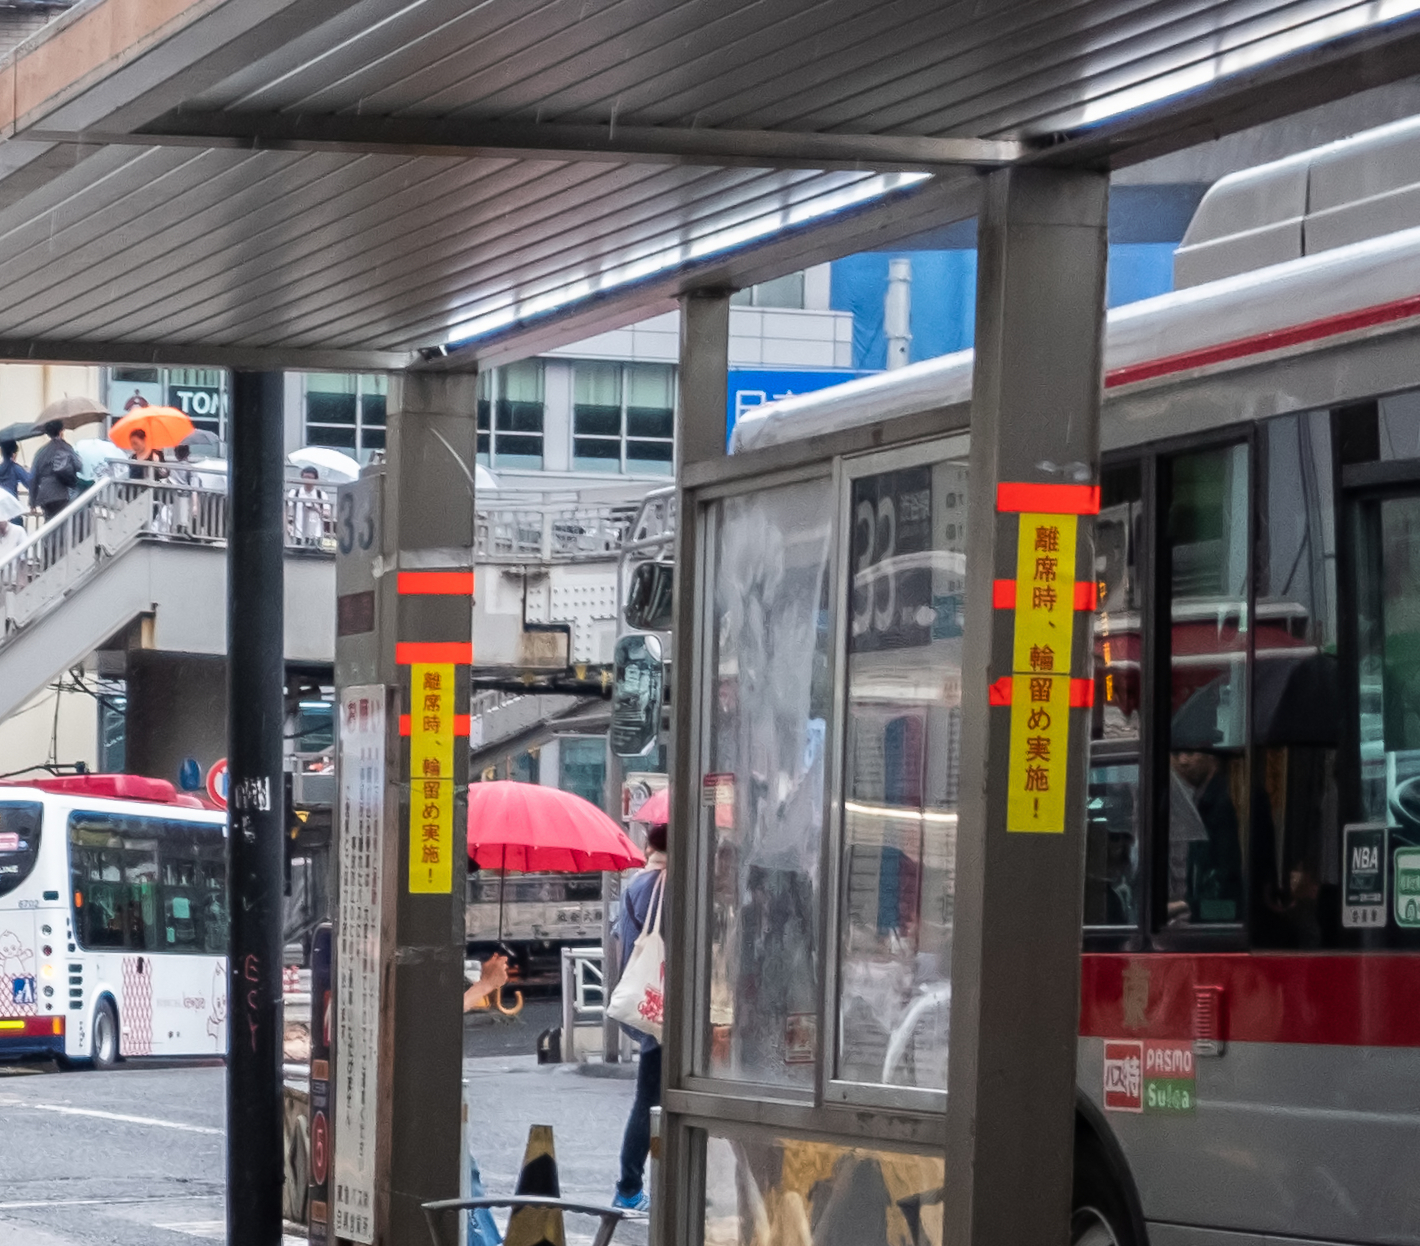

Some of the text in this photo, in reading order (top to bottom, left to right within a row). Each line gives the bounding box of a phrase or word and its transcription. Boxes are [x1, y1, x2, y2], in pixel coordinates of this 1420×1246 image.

[339, 490, 376, 557] 33
[1352, 846, 1379, 869] NBA
[1146, 1048, 1192, 1073] PASMO
